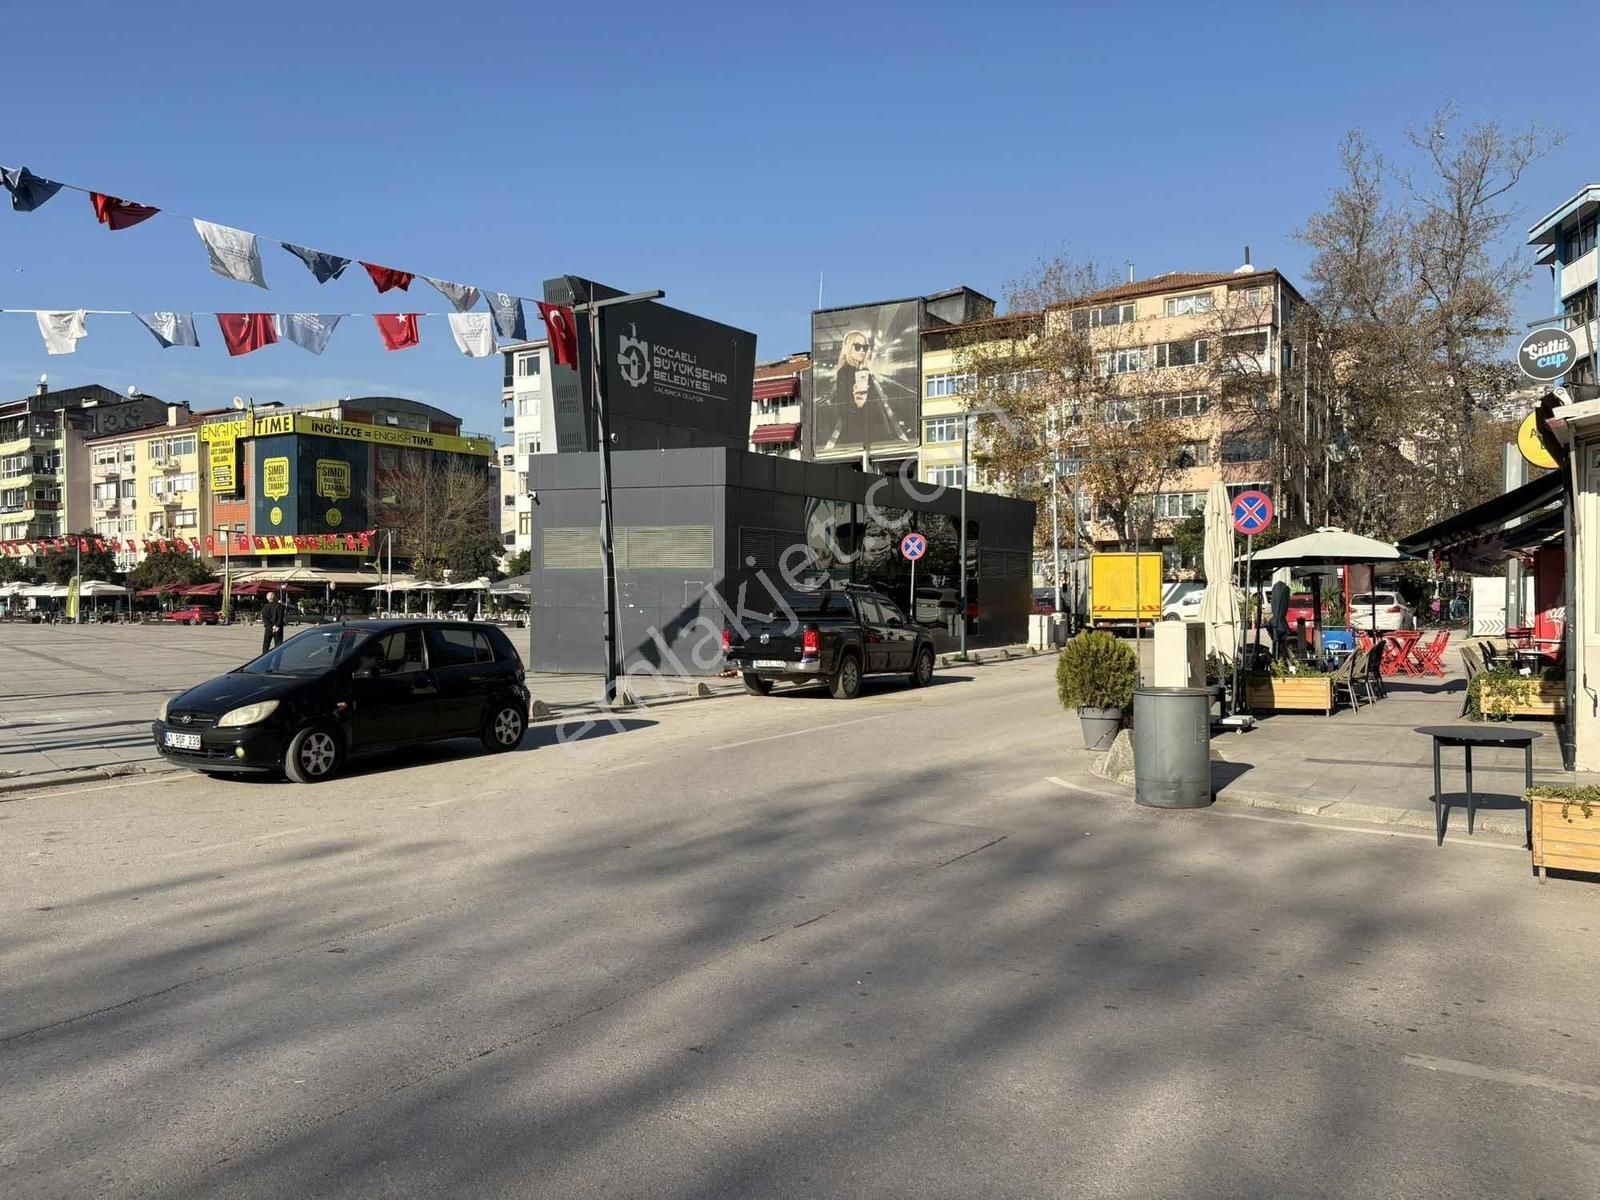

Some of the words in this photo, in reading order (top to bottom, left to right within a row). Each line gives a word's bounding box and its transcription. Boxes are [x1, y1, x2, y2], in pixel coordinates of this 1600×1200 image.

[653, 343, 697, 364] KOCAELİ
[1522, 338, 1571, 361] Sütlü
[1536, 352, 1569, 368] cup
[653, 356, 728, 385] BÜYÜKŞEHİR
[653, 369, 711, 392] BELEDİYESİ
[257, 416, 290, 435] TIME
[374, 431, 412, 443] ENGLISH
[413, 434, 434, 447] TIME
